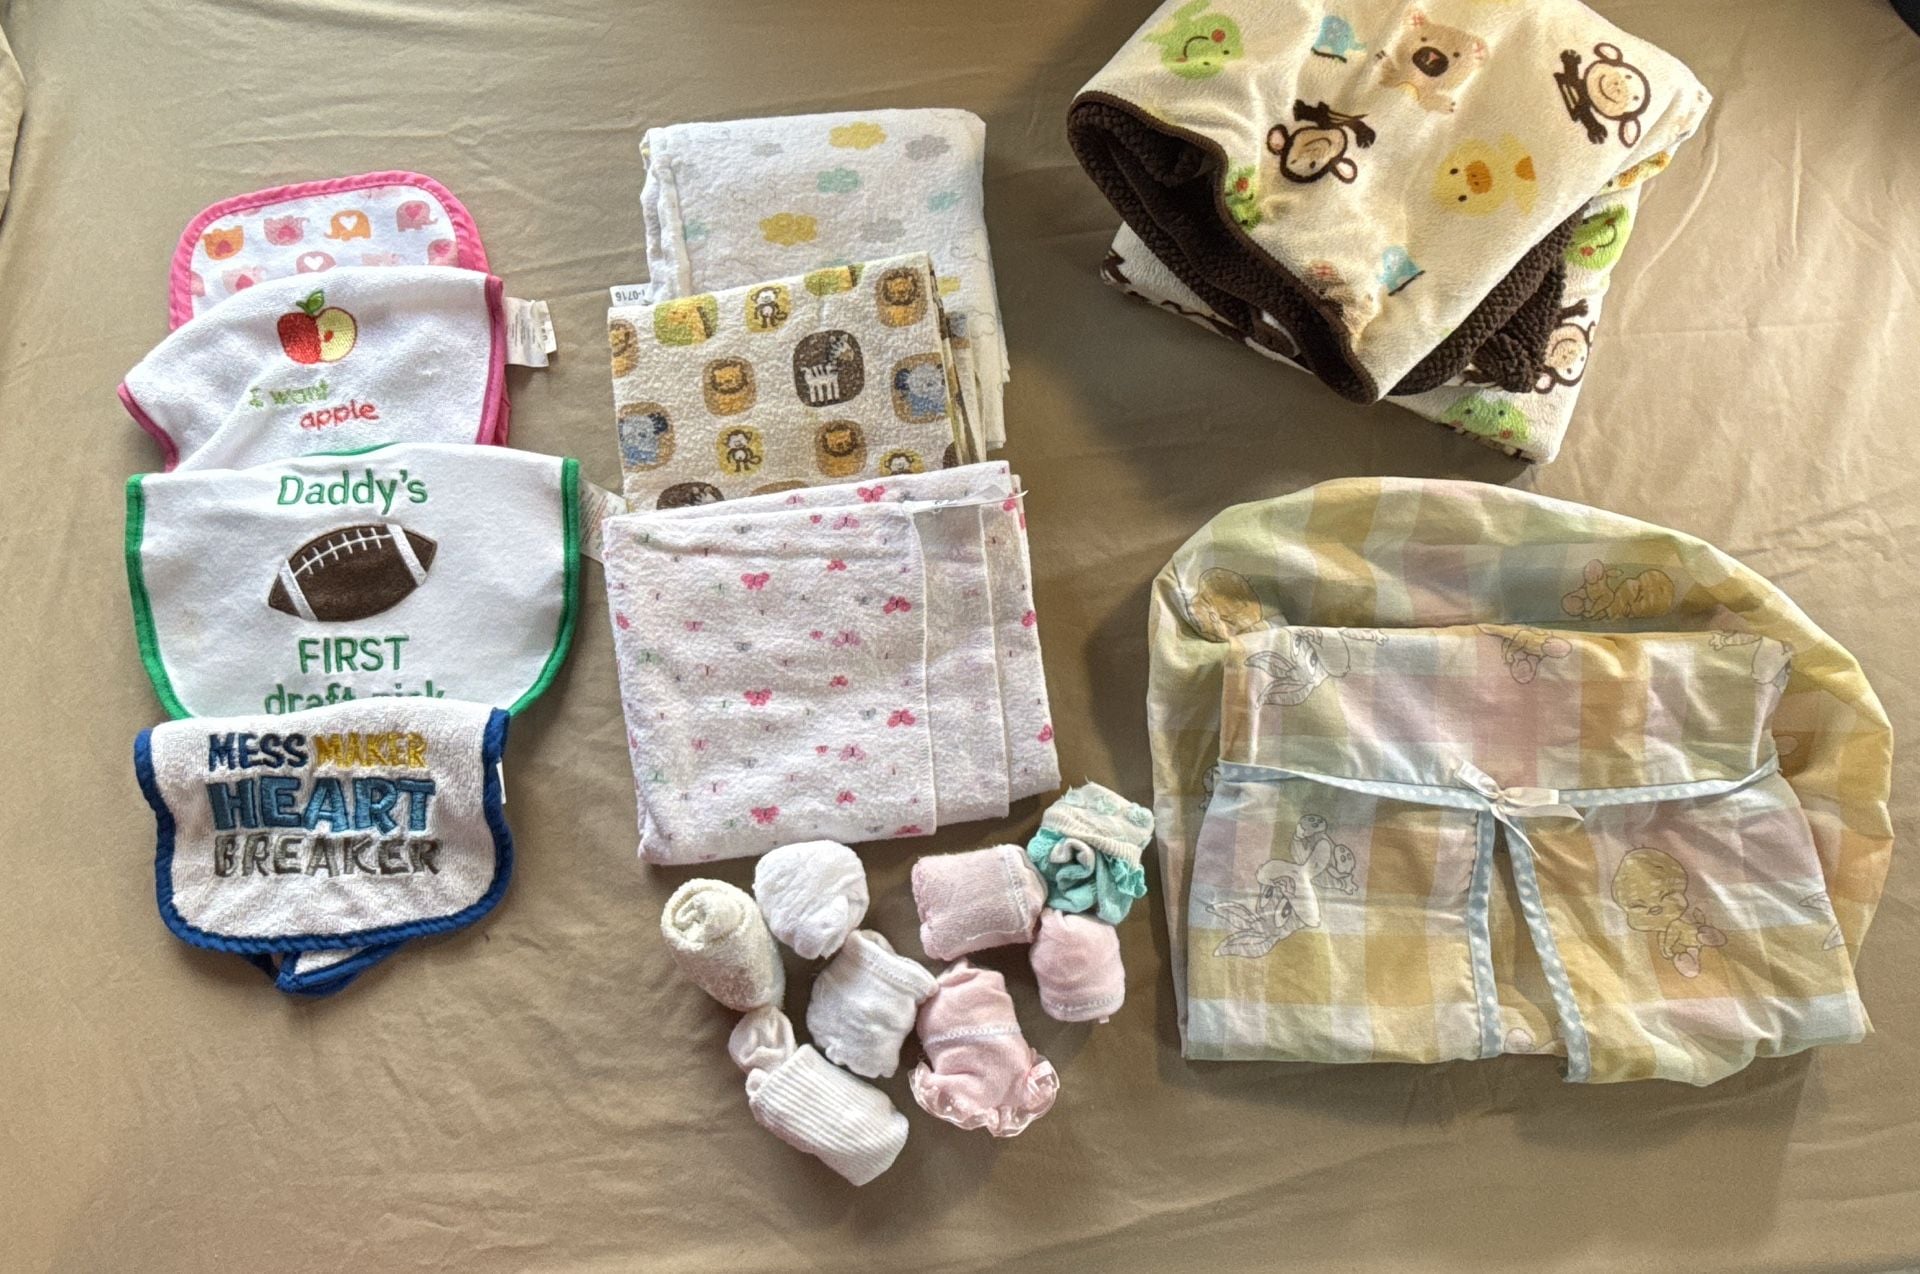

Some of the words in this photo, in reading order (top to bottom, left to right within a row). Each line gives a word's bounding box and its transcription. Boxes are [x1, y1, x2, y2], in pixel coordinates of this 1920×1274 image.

[269, 378, 329, 405] want
[300, 399, 379, 430] apple
[277, 468, 428, 516] Daddy's
[299, 634, 410, 674] FIRST
[208, 732, 309, 772] MESS
[313, 731, 428, 769] MAKER
[207, 775, 437, 835] HEART
[212, 830, 441, 878] BREAKER
